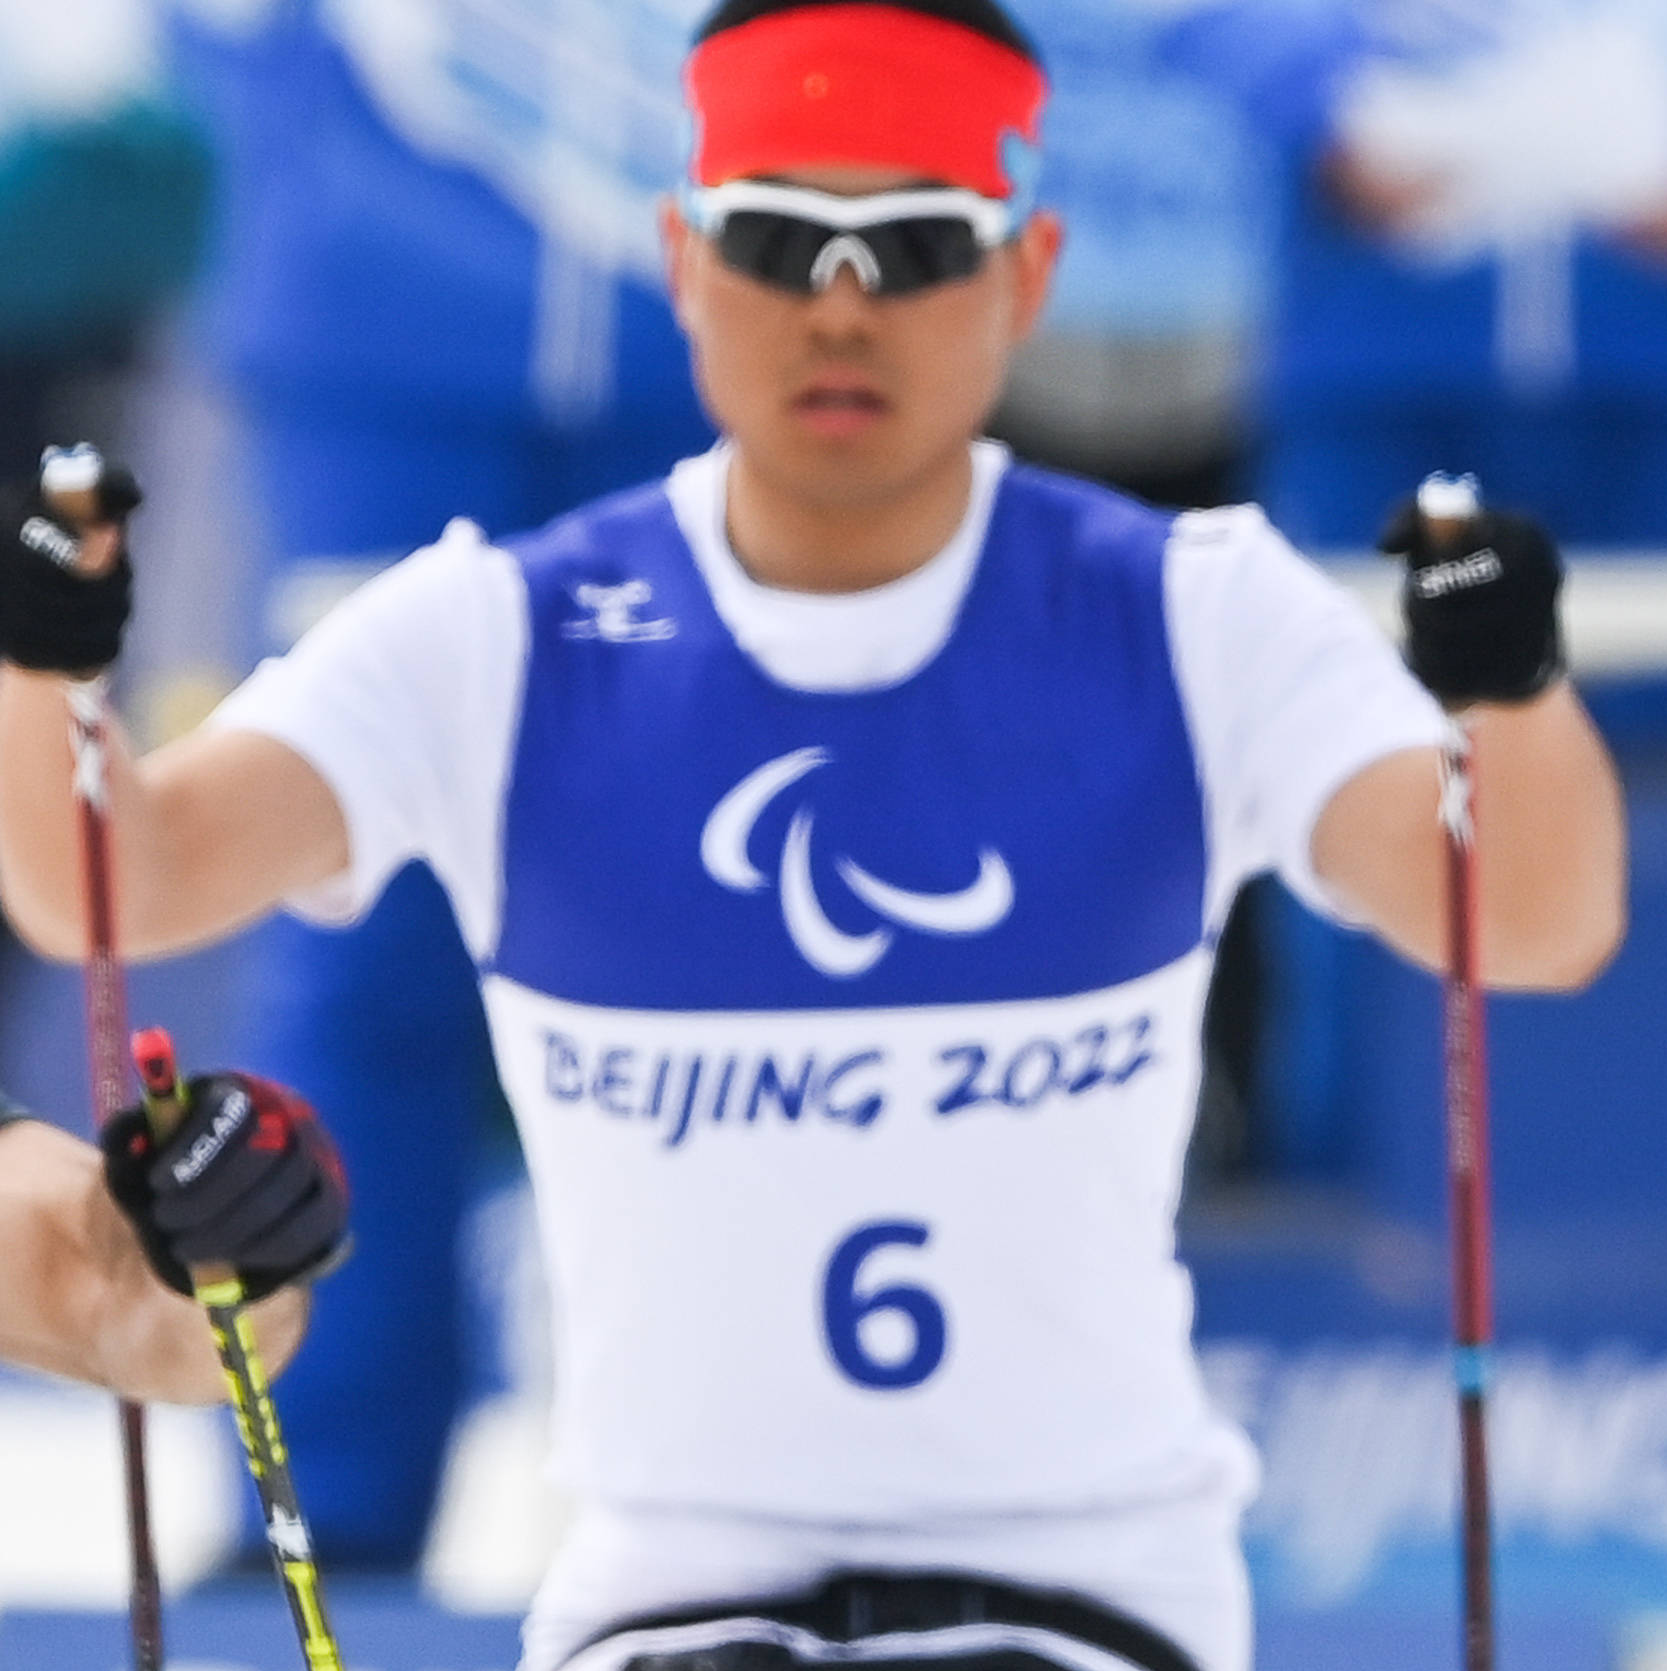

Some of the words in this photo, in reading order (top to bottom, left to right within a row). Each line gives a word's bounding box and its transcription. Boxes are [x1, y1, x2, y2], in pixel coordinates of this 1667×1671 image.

[540, 1026, 888, 1150] BEIJING
[932, 1012, 1161, 1117] 2022
[822, 1221, 949, 1392] 6
